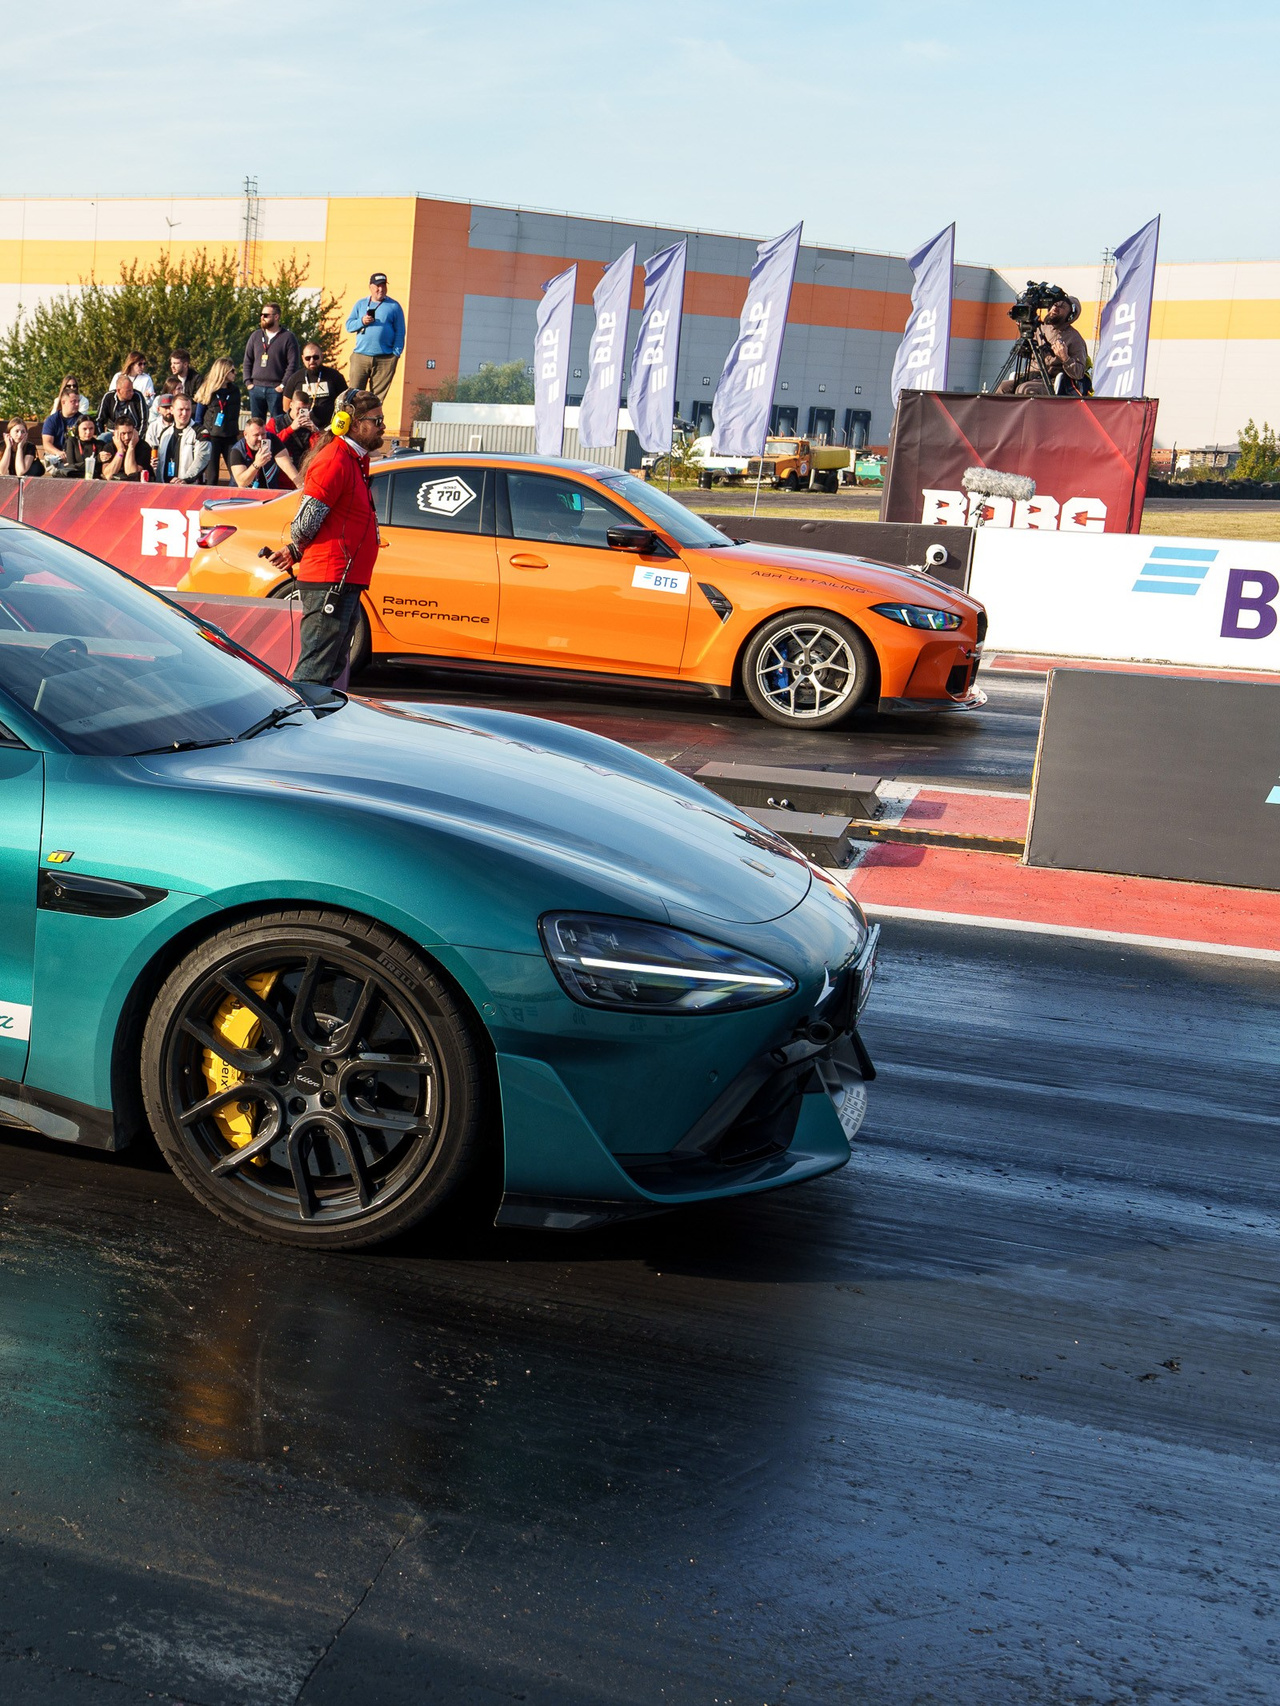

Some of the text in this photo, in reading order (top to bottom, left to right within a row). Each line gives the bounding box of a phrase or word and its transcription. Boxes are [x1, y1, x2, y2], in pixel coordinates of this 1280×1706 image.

[437, 490, 461, 502] 770
[653, 575, 678, 589] ВТБ
[383, 595, 438, 608] Ramon
[382, 608, 490, 624] Performance
